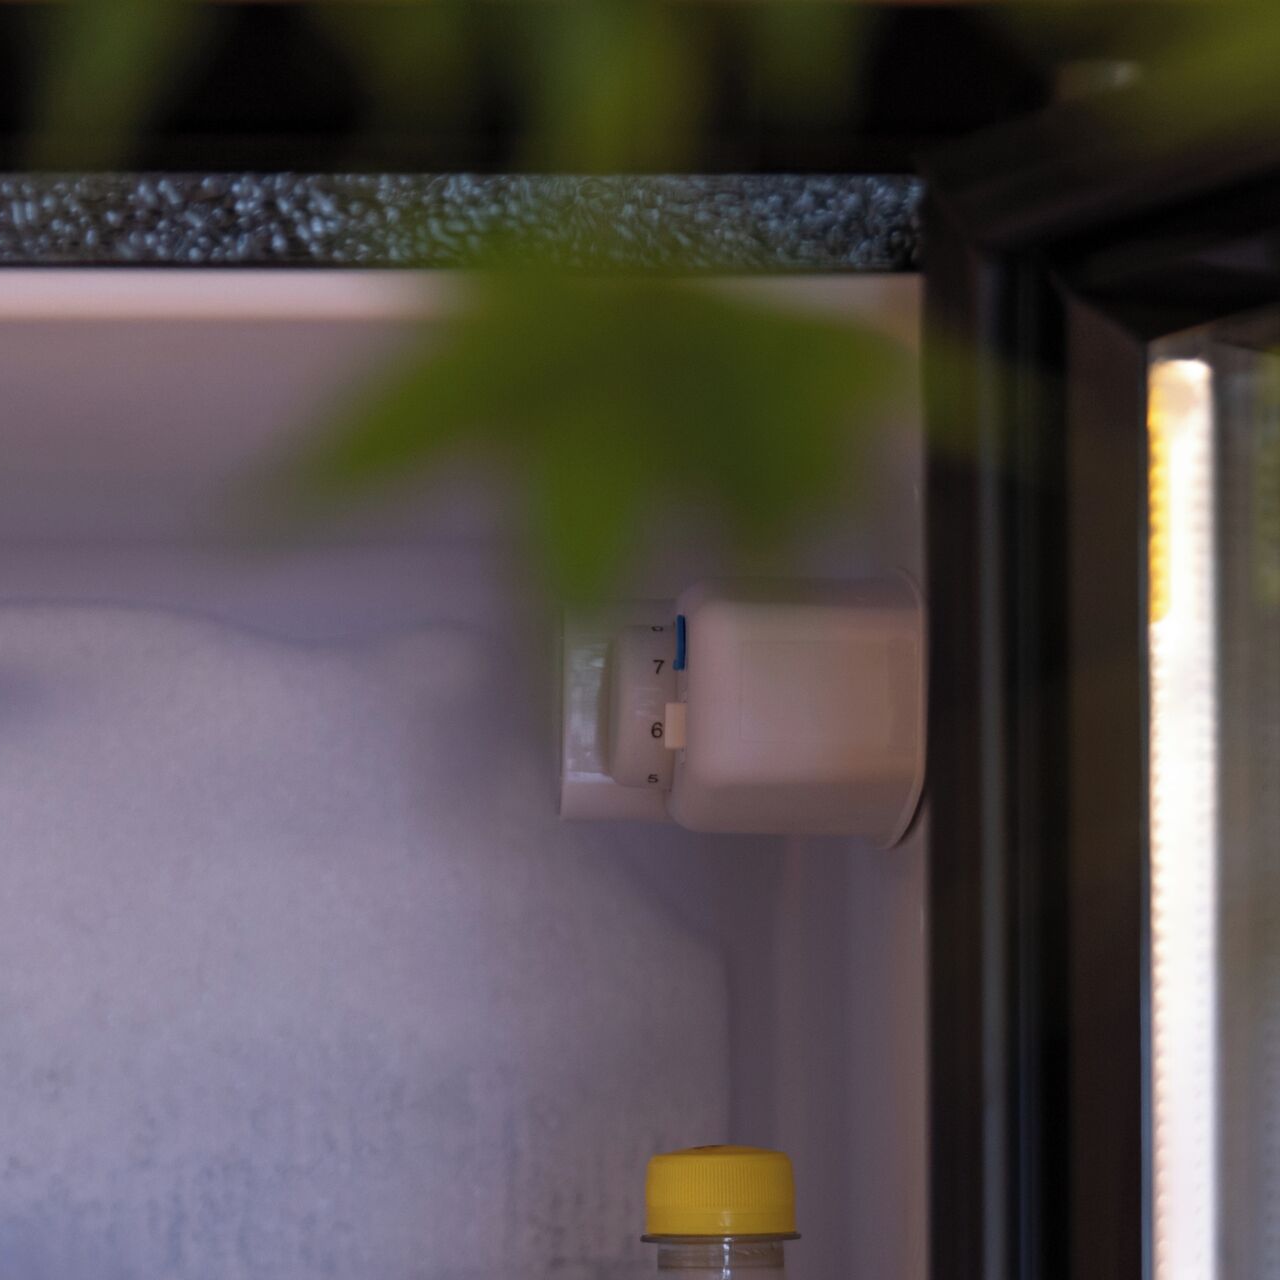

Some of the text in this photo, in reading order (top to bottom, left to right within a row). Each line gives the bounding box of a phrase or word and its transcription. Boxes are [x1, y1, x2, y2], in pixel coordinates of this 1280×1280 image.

[652, 659, 665, 675] 7
[651, 722, 663, 738] 6
[647, 774, 659, 784] 5
